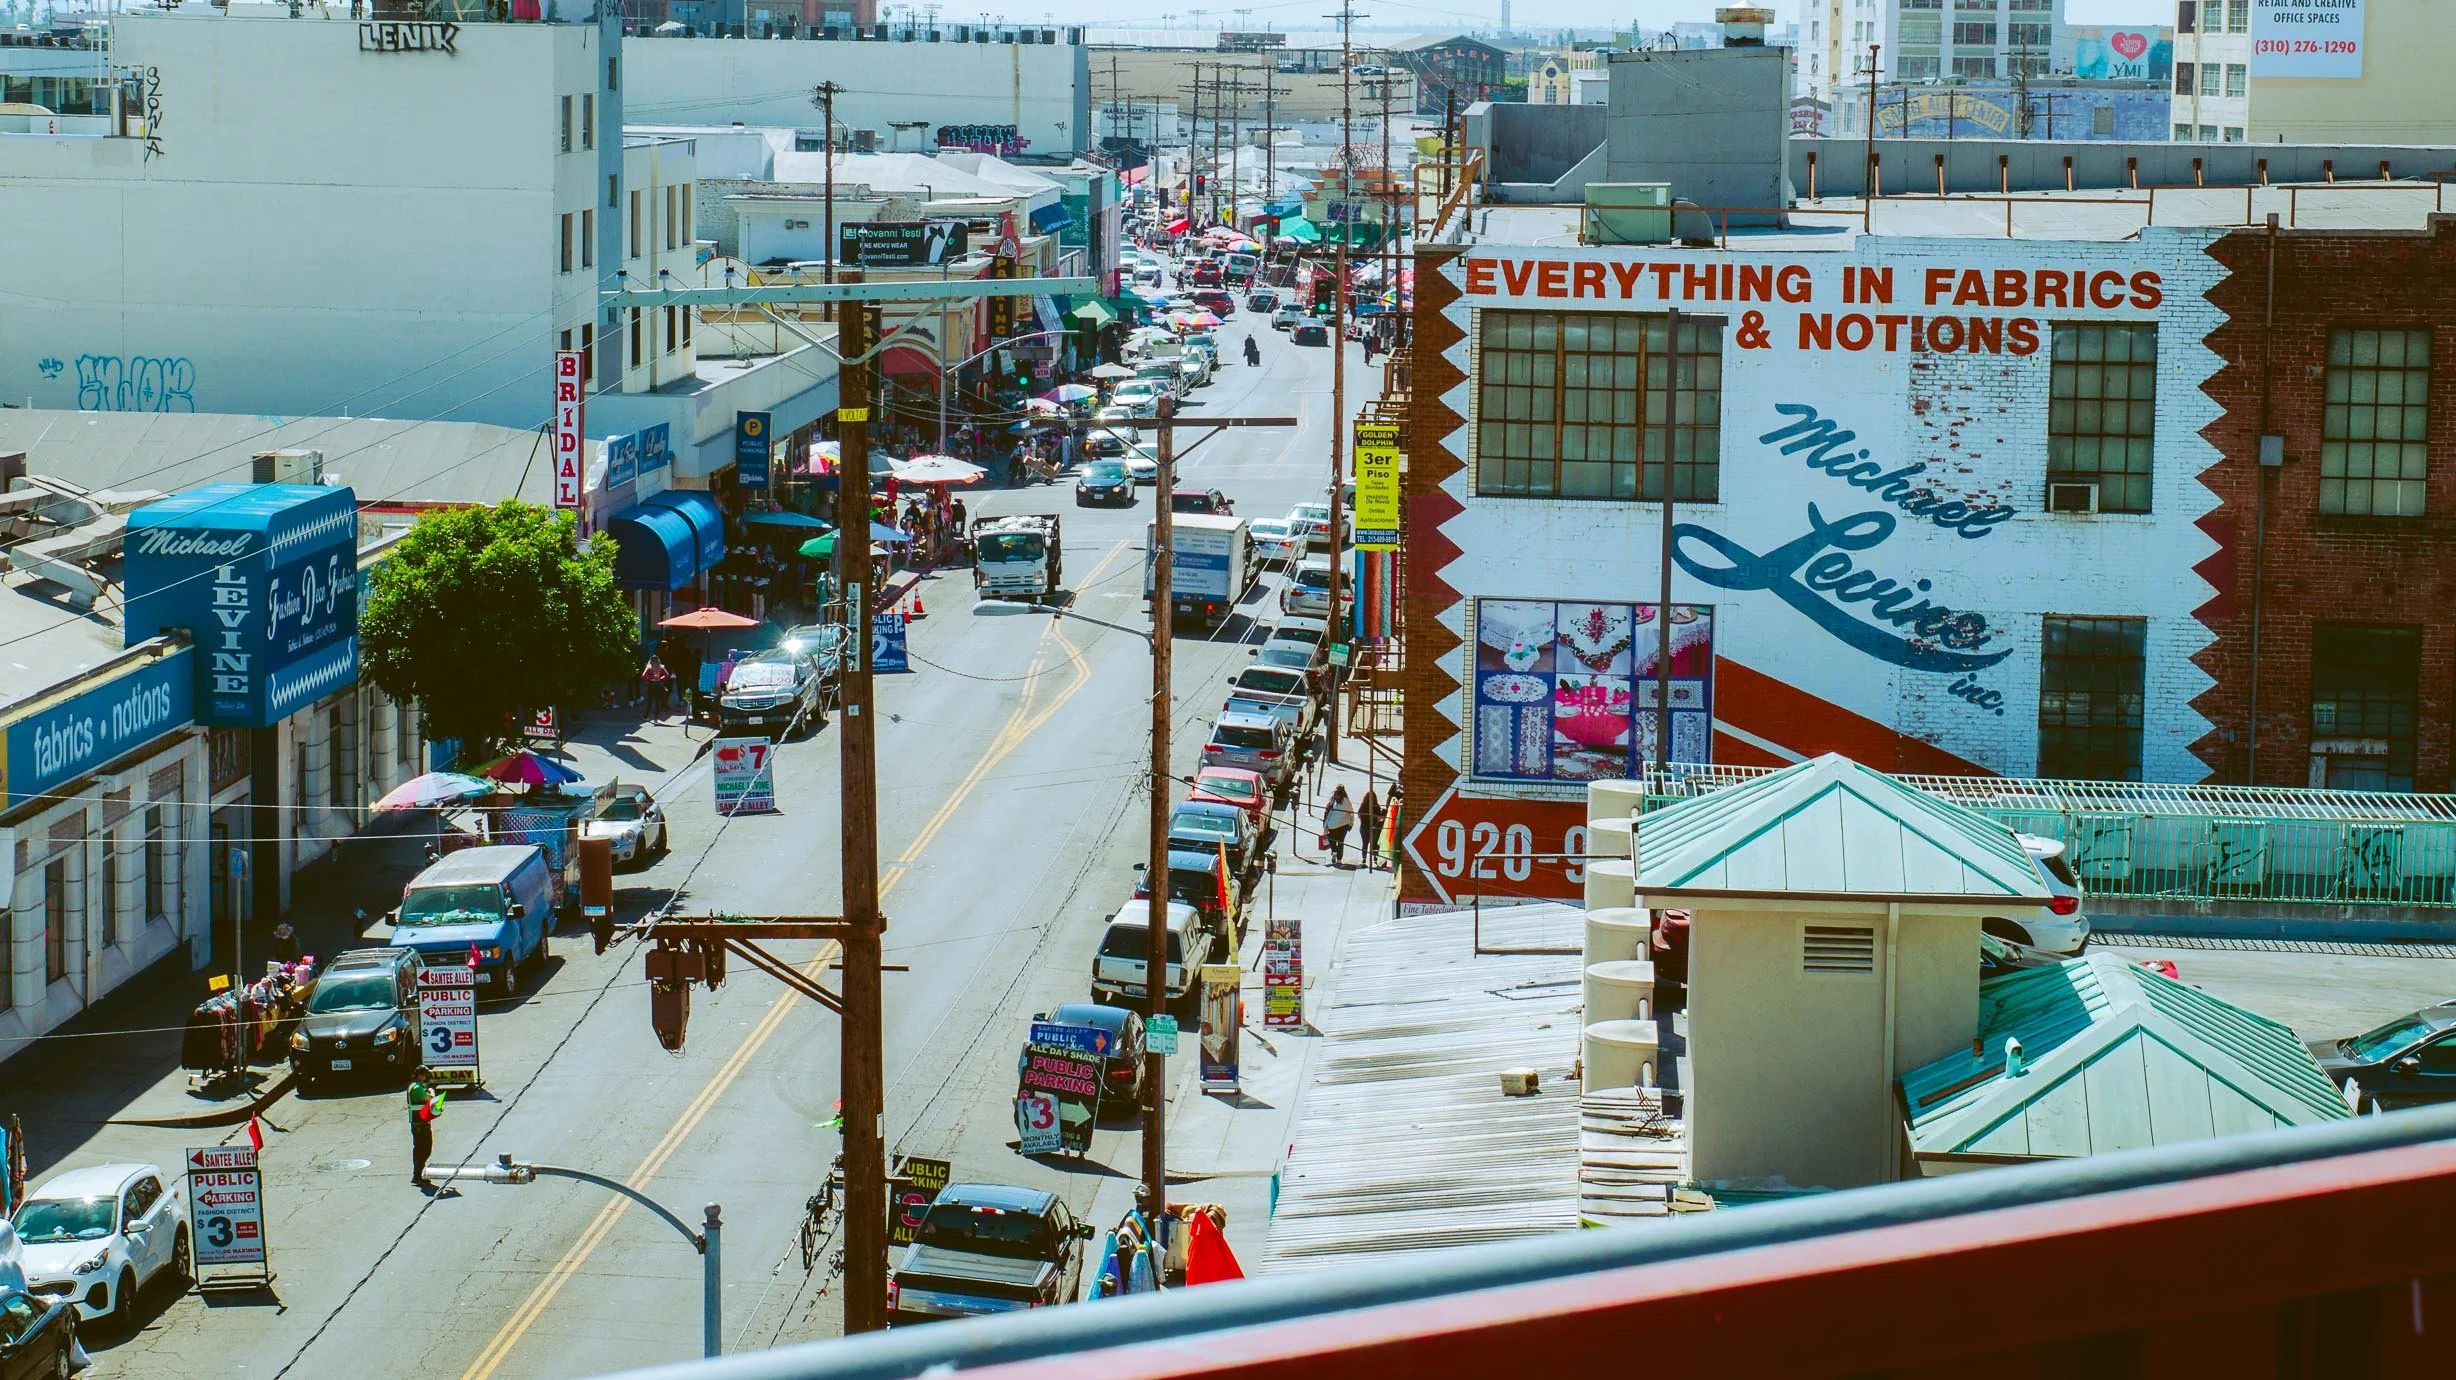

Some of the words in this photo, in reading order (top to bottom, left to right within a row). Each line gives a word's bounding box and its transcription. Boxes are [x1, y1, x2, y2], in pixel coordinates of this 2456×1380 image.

[2258, 0, 2289, 8] RETAIL
[2291, 0, 2311, 8] AND
[2314, 0, 2356, 9] CREATIVE
[2274, 13, 2304, 24] OFFICE
[2307, 13, 2340, 24] SPACES
[2255, 40, 2290, 55] (310)
[2294, 41, 2356, 54] 276-1290
[2113, 61, 2141, 77] YMI
[901, 228, 921, 238] Testi
[1465, 258, 1812, 302] EVERYTHING
[1843, 266, 1892, 304] IN
[1924, 267, 2163, 310] FABRICS
[1735, 313, 1771, 349] &
[1799, 313, 2040, 355] NOTIONS
[559, 356, 577, 503] BRIDAL
[1362, 431, 1393, 439] GOLDEN
[1364, 452, 1392, 465] 3er
[1367, 469, 1390, 478] Piso
[1759, 403, 2015, 540] Michael
[138, 528, 253, 556] Michael
[1672, 501, 2014, 673] Levine
[267, 577, 301, 641] Fashion
[872, 615, 893, 624] BLIC
[211, 565, 252, 693] LEVINE
[873, 625, 894, 634] KING
[1947, 672, 2005, 717] inc.
[34, 714, 94, 779] fabrics
[112, 682, 171, 743] notions
[525, 726, 539, 734] ALL
[739, 744, 746, 759] $
[749, 744, 767, 769] 7
[717, 782, 745, 792] MICHAEL
[746, 781, 770, 790] LVINE
[742, 791, 770, 799] STRICT
[719, 802, 745, 812] SANTE
[748, 801, 769, 810] ALLEY
[1403, 904, 1420, 914] Fine
[430, 972, 453, 985] SANTEE
[455, 972, 473, 984] ALLEY
[421, 990, 471, 1002] PUBLIC
[429, 1006, 471, 1016] PARKING
[422, 1028, 429, 1038] $
[430, 1026, 453, 1054] 3
[1037, 1031, 1077, 1043] PUBLIC
[1030, 1045, 1048, 1054] ALL
[1049, 1047, 1071, 1057] DAY
[1070, 1051, 1101, 1063] SHADE
[1032, 1055, 1094, 1079] PUBLIC
[450, 1070, 474, 1080] DAY
[1025, 1070, 1096, 1095] PARKING
[1031, 1097, 1055, 1130] 3
[1022, 1133, 1060, 1142] MONTHLY
[1023, 1141, 1060, 1149] AVAILABLE
[204, 1153, 232, 1167] SANTEE
[234, 1152, 255, 1166] ALLEY
[194, 1173, 255, 1187] PUBLIC
[912, 1176, 945, 1190] RKING
[204, 1192, 254, 1204] PARKING
[196, 1218, 205, 1229] $
[207, 1216, 234, 1248] 3
[893, 1226, 913, 1242] ALL
